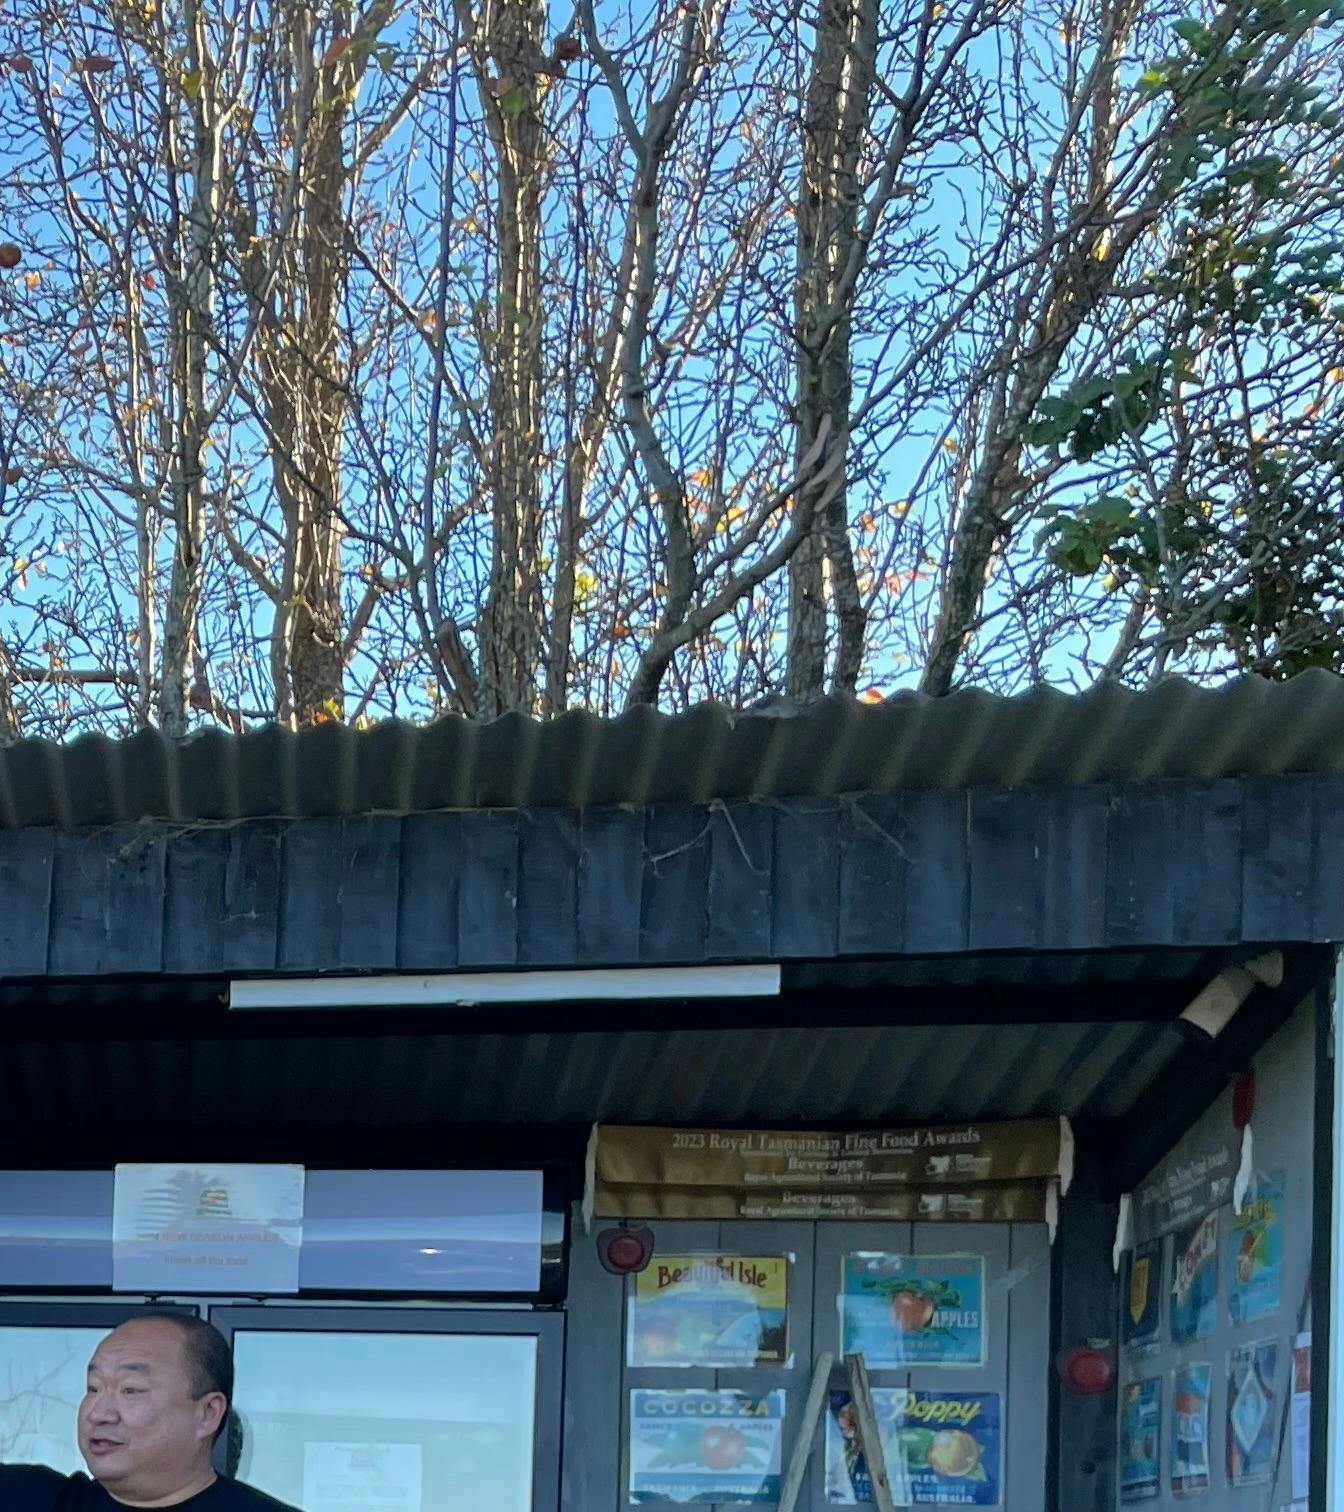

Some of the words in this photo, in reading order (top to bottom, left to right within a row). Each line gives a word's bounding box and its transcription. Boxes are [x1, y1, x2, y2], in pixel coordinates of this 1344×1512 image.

[672, 1133, 704, 1149] 2023
[710, 1133, 752, 1153] Royal
[758, 1134, 840, 1151] Tasmanian
[845, 1133, 878, 1152] Fine
[882, 1131, 919, 1148] Food
[923, 1127, 981, 1146] Awards
[788, 1157, 863, 1173] Beverages
[782, 1192, 856, 1207] Beverages
[738, 1261, 768, 1288] Isle
[931, 1311, 979, 1328] APPLES
[643, 1400, 769, 1416] COCOZZA
[889, 1391, 981, 1425] Poppy
